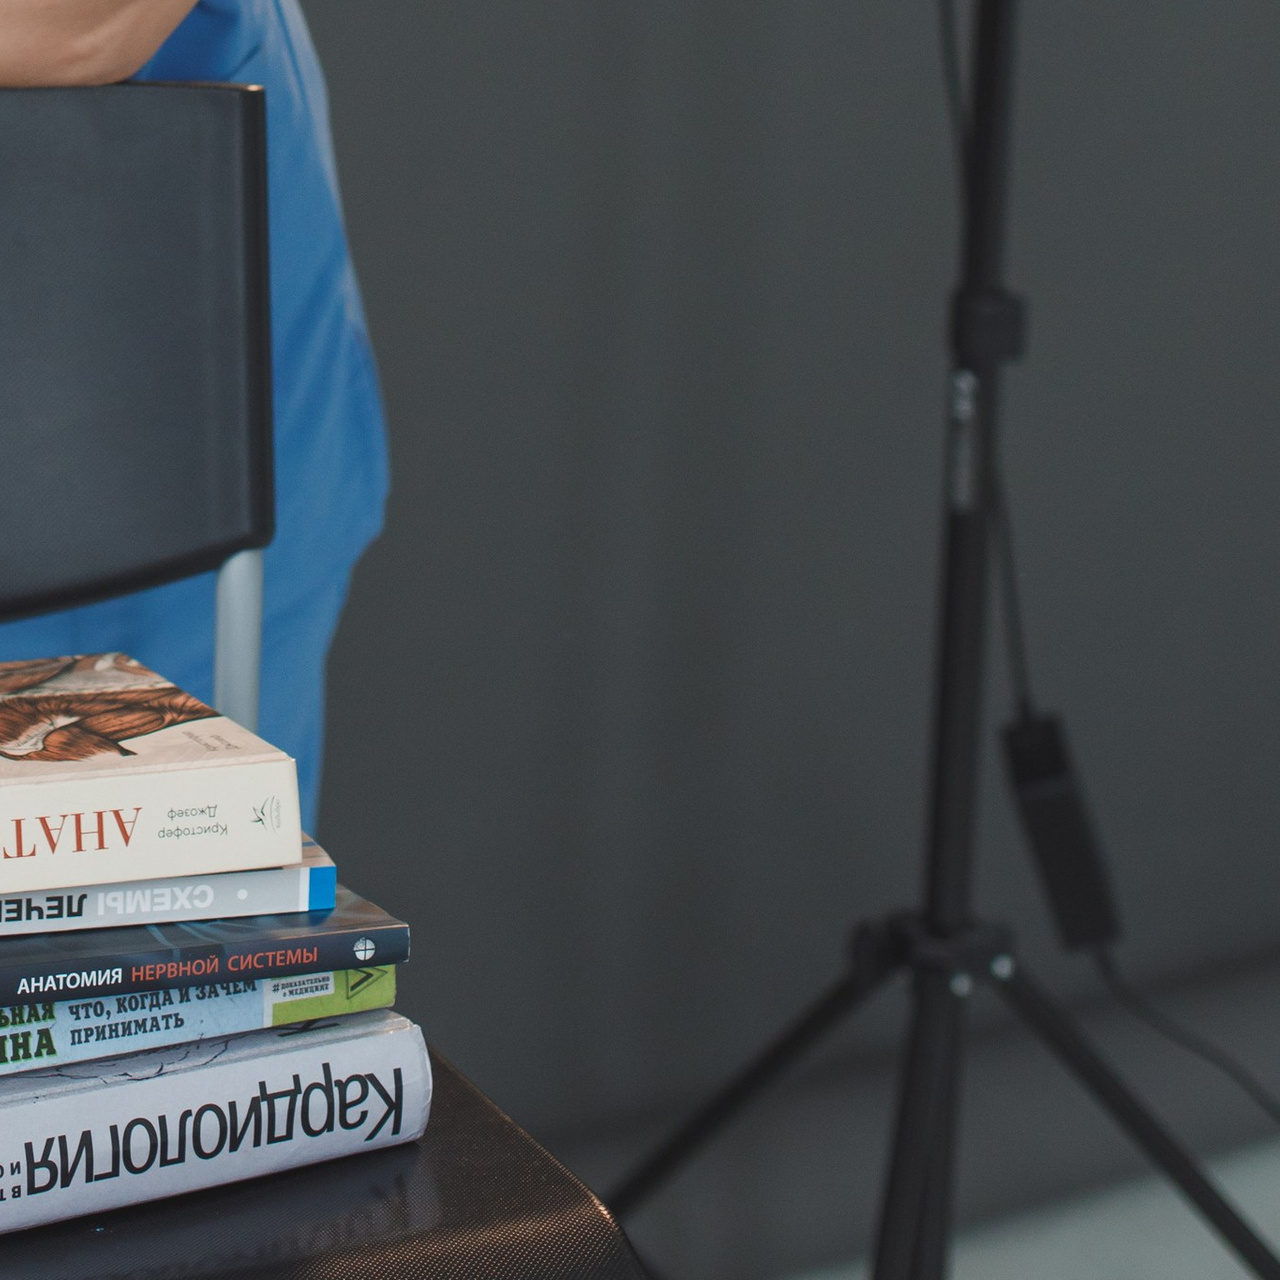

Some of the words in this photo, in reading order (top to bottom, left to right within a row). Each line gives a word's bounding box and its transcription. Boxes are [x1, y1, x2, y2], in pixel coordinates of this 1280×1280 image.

[167, 804, 218, 820] Джозеф
[158, 823, 228, 839] Кристофер
[97, 884, 214, 916] СХЕМЫ
[17, 968, 123, 994] АНАТОМИЯ
[131, 955, 219, 982] НЕРВНОЙ
[227, 947, 318, 971] СИСТЕМЫ
[69, 1001, 112, 1021] ЧТО,
[116, 990, 174, 1014] КОГДА
[179, 990, 191, 1004] И
[195, 979, 257, 1000] ЗАЧЕМ
[288, 984, 330, 997] МЕДИЦИНЕ
[70, 1013, 185, 1046] ПРИНИМАТЬ
[24, 1063, 404, 1196] Кардиология
[10, 1161, 21, 1176] и
[11, 1185, 22, 1198] в
